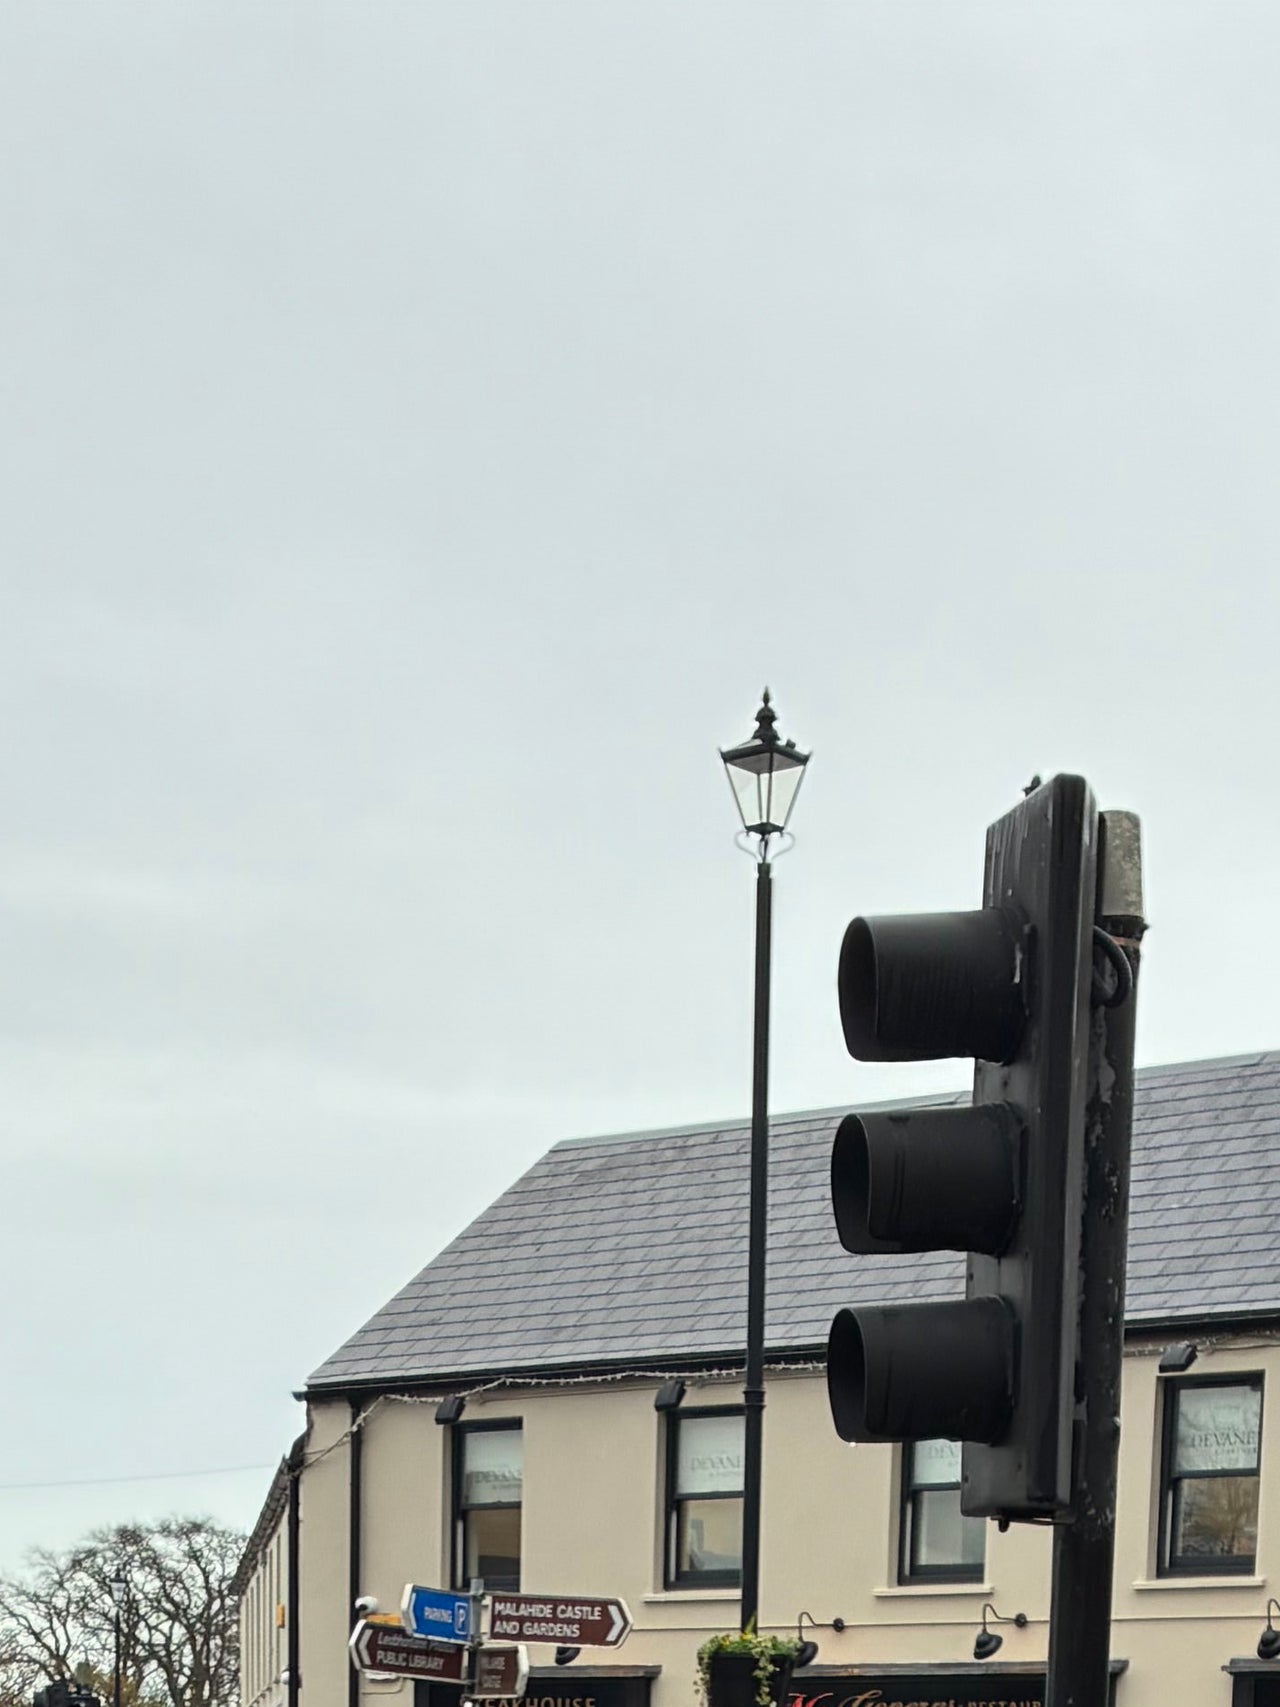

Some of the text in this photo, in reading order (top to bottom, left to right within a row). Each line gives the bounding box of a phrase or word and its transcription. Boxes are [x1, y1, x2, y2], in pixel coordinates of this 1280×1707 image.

[424, 1606, 452, 1623] PARKING
[494, 1602, 602, 1620] MALAHIDE CASTLE
[493, 1620, 580, 1637] AND GARDENS
[376, 1649, 445, 1671] PUBLIC LIBRARY
